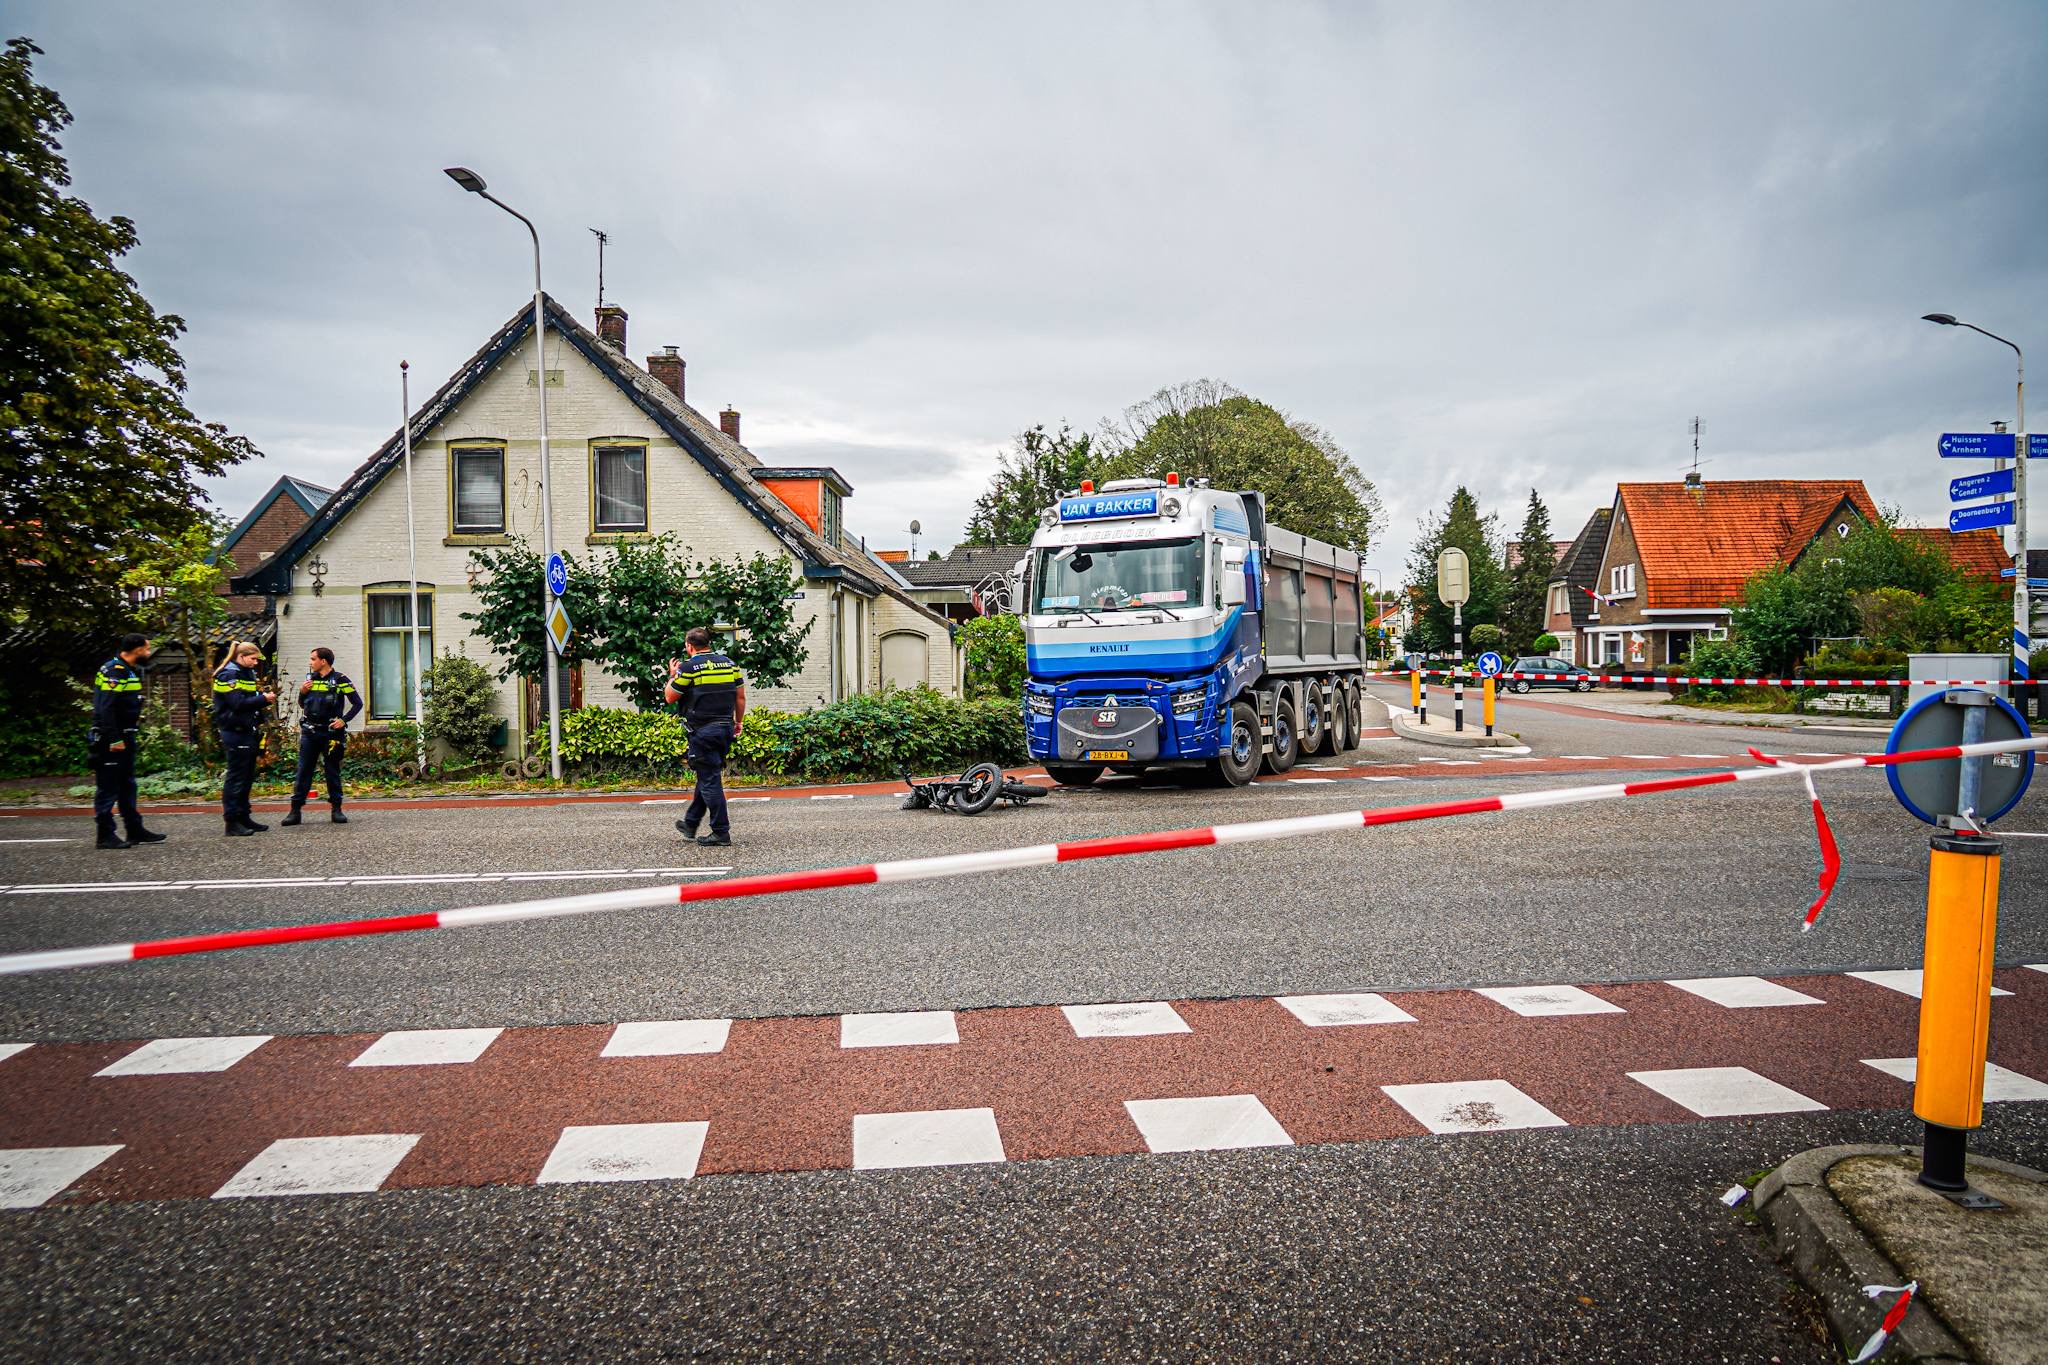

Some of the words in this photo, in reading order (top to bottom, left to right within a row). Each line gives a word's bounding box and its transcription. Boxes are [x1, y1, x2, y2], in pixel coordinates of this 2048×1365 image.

[2031, 436, 2048, 444] Bem
[1951, 446, 1981, 454] Arnhem
[2031, 447, 2048, 456] Nijm
[1958, 477, 1985, 487] Angeren
[1958, 488, 1978, 497] Gendt
[1062, 503, 1090, 516] JAN
[1095, 498, 1153, 513] BAKKER
[1958, 506, 2001, 518] Doornenburg
[1090, 644, 1129, 653] RENAULT
[1098, 711, 1117, 722] SR
